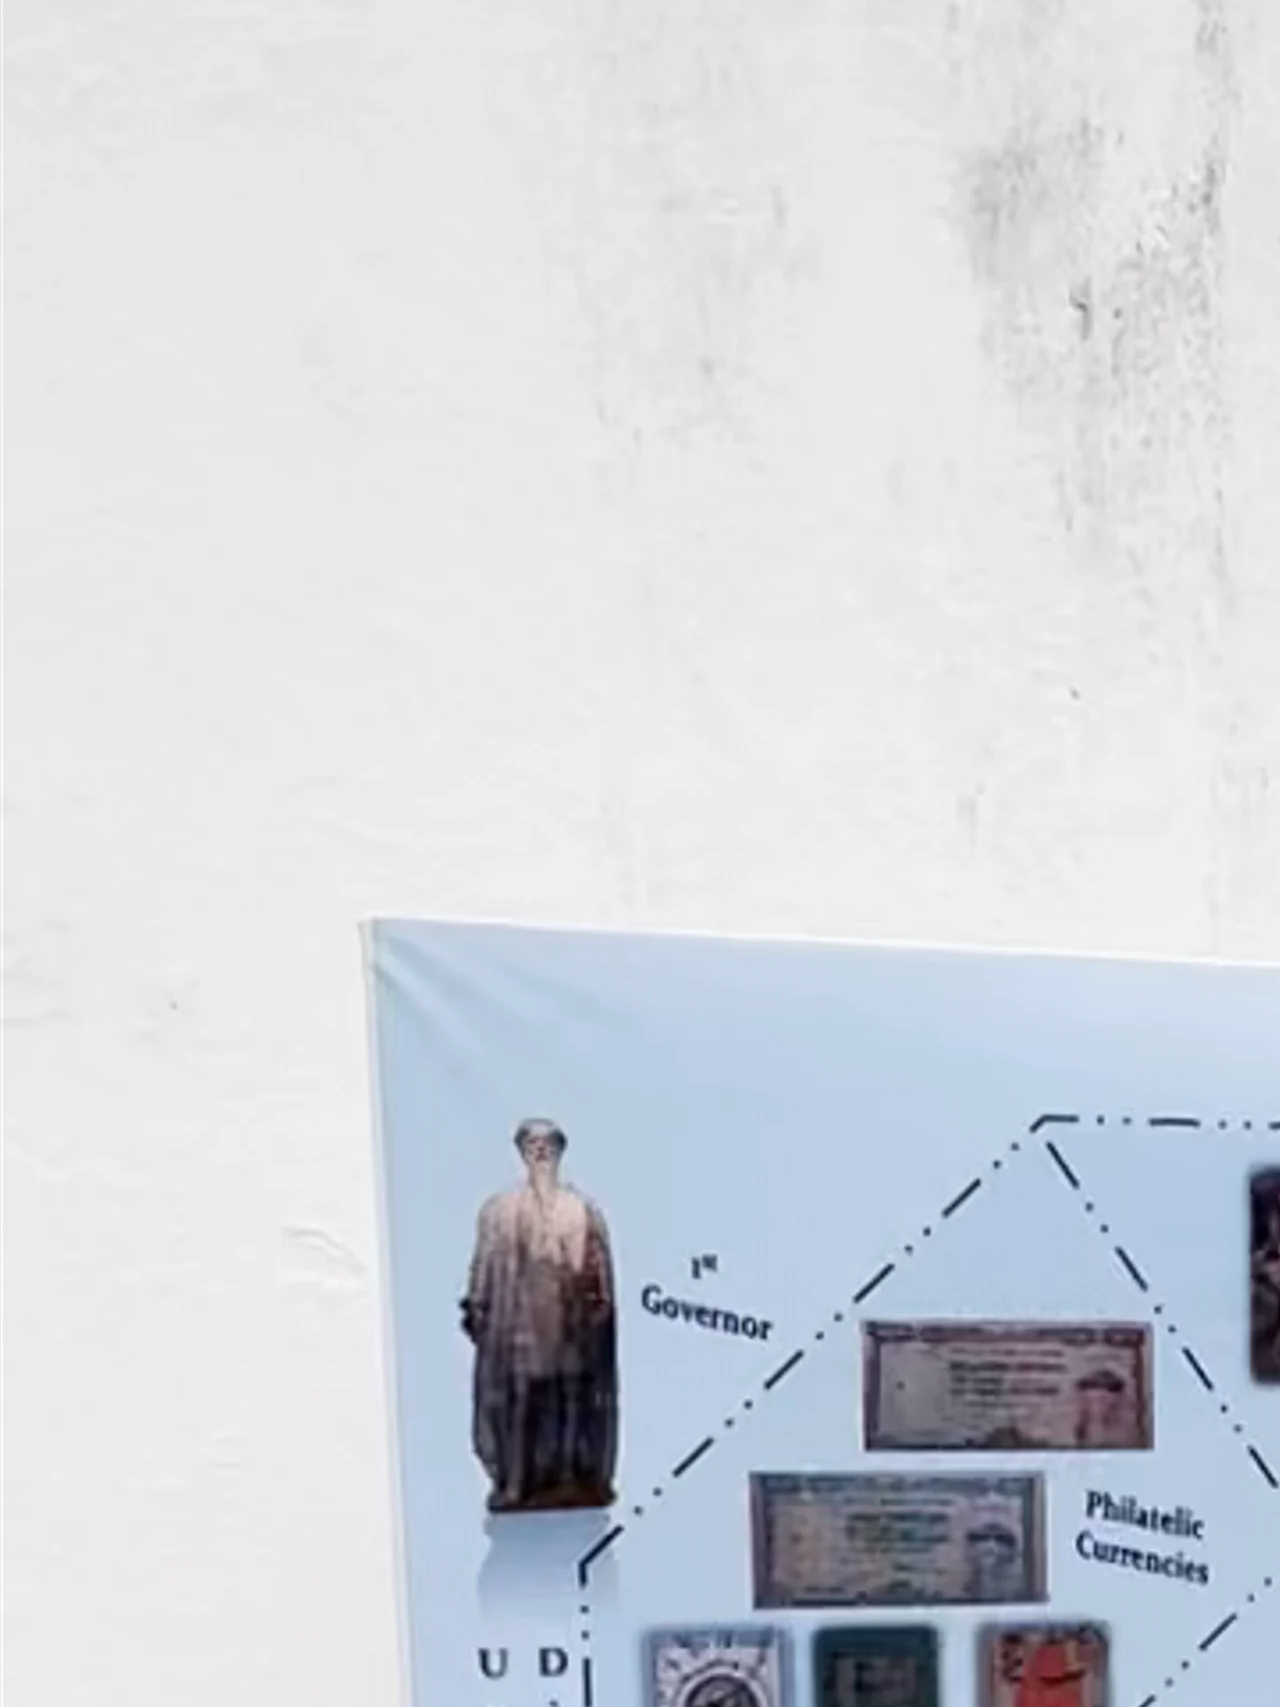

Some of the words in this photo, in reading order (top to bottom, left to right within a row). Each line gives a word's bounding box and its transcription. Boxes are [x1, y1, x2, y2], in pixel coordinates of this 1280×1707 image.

[642, 1283, 774, 1339] Governor
[1086, 1489, 1204, 1540] Philatelic
[1075, 1530, 1209, 1585] Currencies
